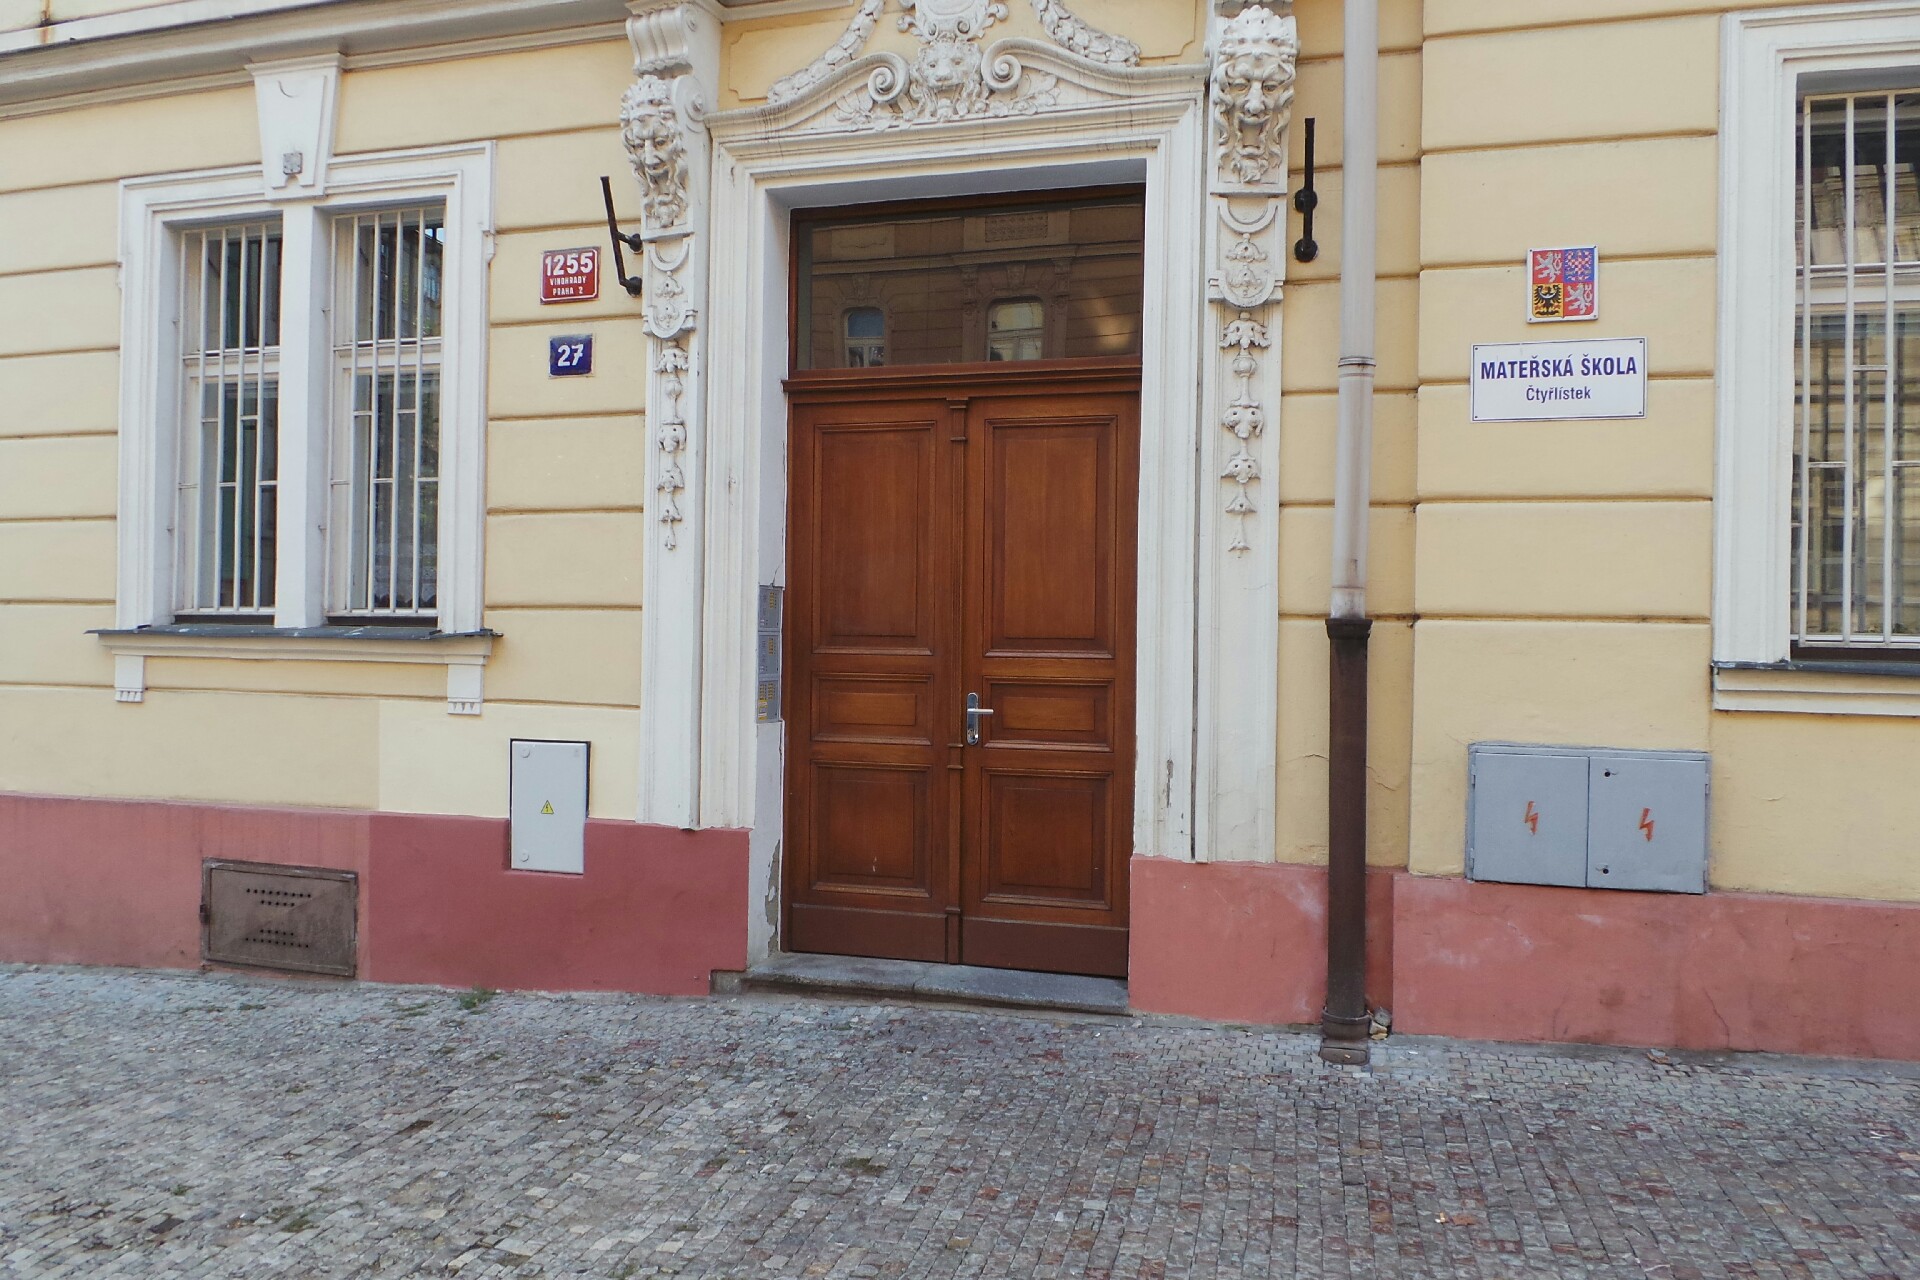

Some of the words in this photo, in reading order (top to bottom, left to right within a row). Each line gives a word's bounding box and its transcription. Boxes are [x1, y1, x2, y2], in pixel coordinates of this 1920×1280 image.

[545, 252, 593, 276] 1255
[549, 276, 586, 286] VINOHRADY
[552, 288, 574, 296] PRAHA
[578, 286, 583, 294] 2
[557, 343, 584, 367] 27
[1481, 354, 1574, 380] MATEŘSKÁ
[1581, 353, 1637, 376] ŠKOLA
[1526, 385, 1591, 403] Čtyřlístek
